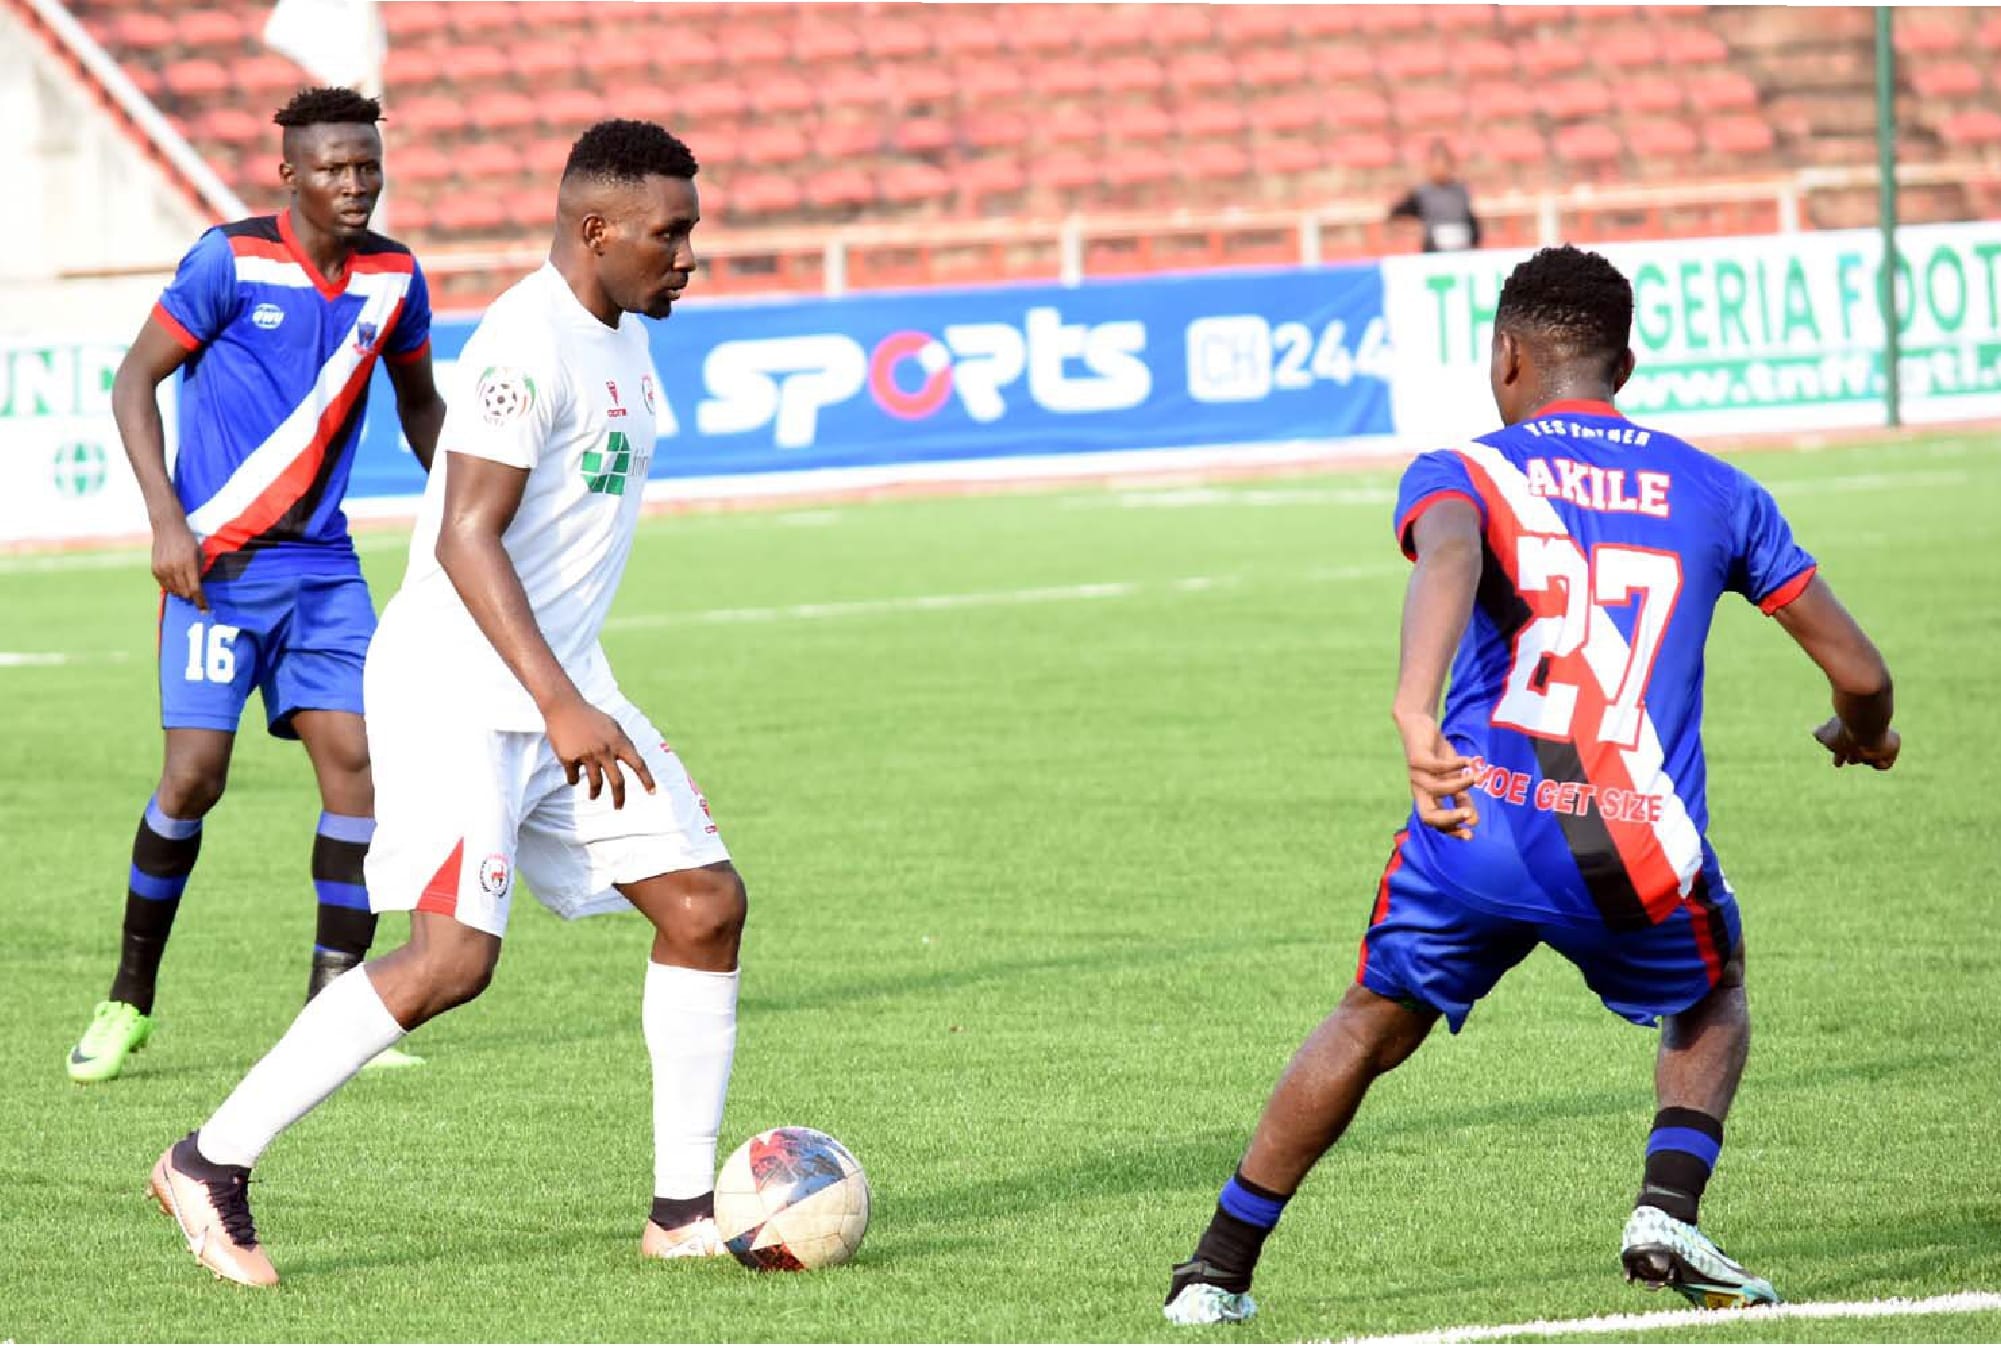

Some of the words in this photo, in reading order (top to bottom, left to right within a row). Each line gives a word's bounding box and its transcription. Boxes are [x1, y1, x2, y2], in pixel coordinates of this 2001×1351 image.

[1424, 271, 1503, 365] TH
[1634, 254, 1823, 351] GERIA
[1526, 455, 1672, 521] AKILE
[184, 620, 241, 684] 16
[1490, 530, 1684, 753] 27
[1534, 778, 1598, 816] GET
[1601, 787, 1665, 824] SIZE
